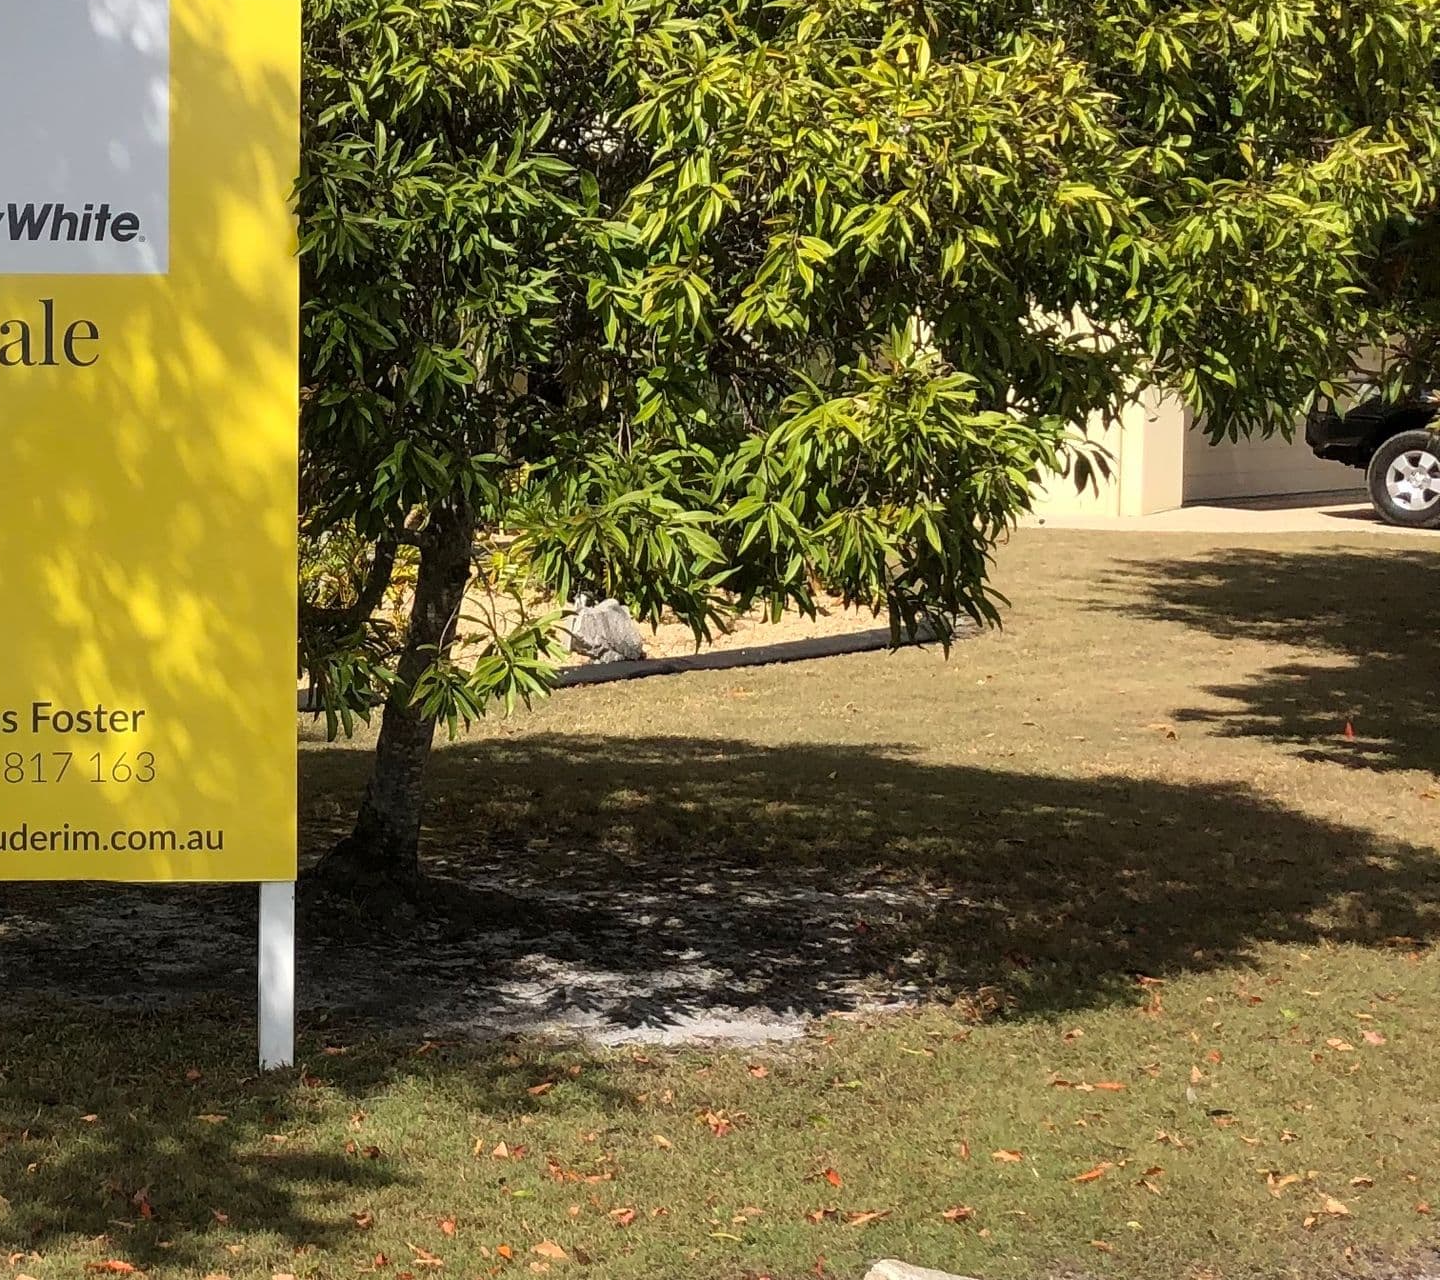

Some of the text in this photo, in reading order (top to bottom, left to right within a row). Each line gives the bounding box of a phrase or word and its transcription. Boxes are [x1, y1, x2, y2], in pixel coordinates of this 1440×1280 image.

[31, 701, 146, 734] Foster
[3, 751, 74, 784] 817
[89, 751, 156, 784] 163
